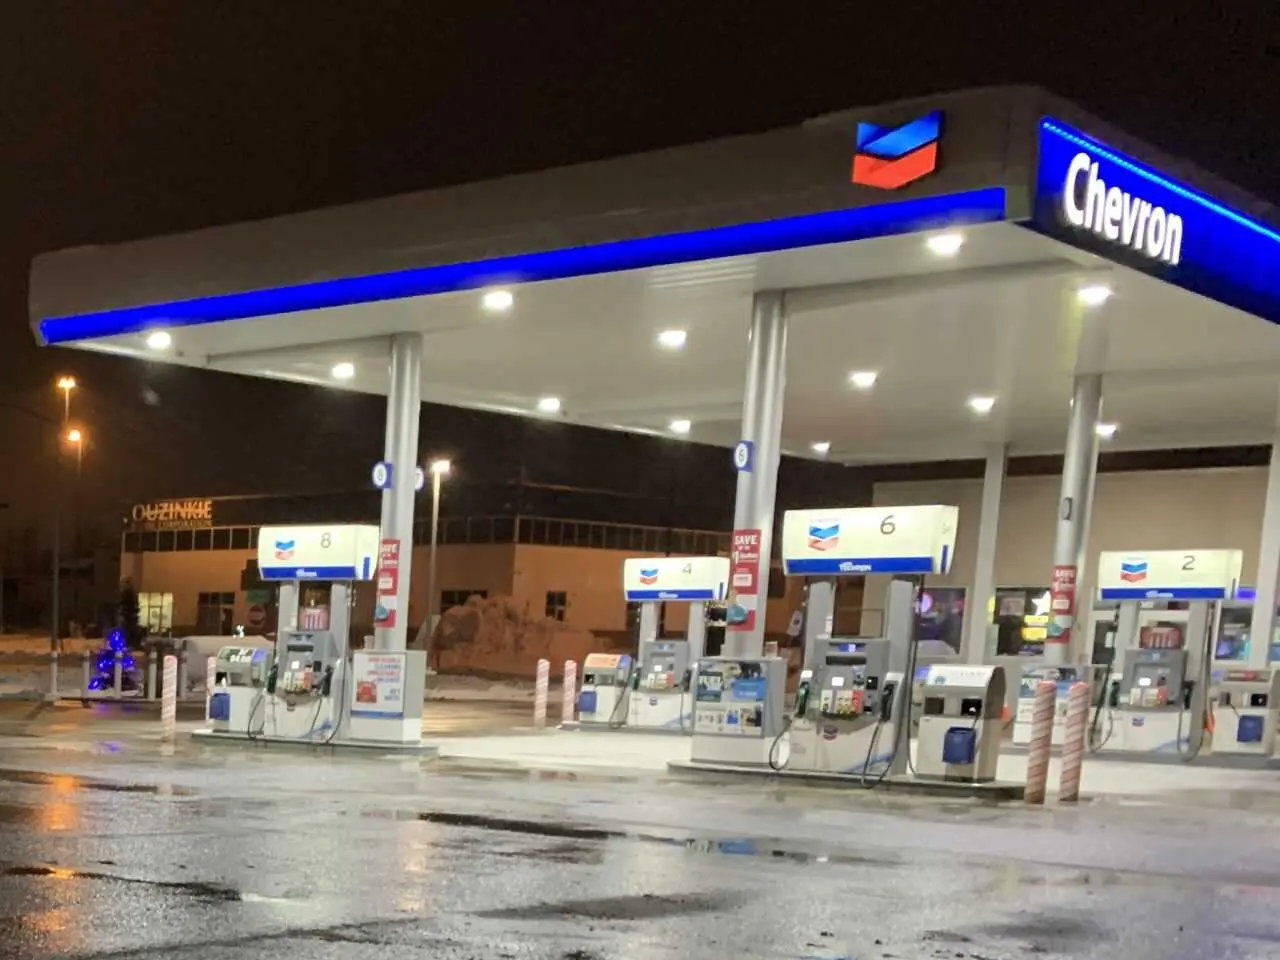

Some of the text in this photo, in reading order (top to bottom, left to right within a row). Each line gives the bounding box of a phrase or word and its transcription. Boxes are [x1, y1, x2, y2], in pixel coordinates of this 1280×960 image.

[1065, 152, 1183, 265] Chevron
[132, 500, 212, 520] OUZINKIE
[880, 515, 895, 534] 6
[320, 532, 331, 548] 8
[735, 535, 757, 544] SAVE
[683, 563, 692, 574] 4
[1182, 555, 1195, 570] 2
